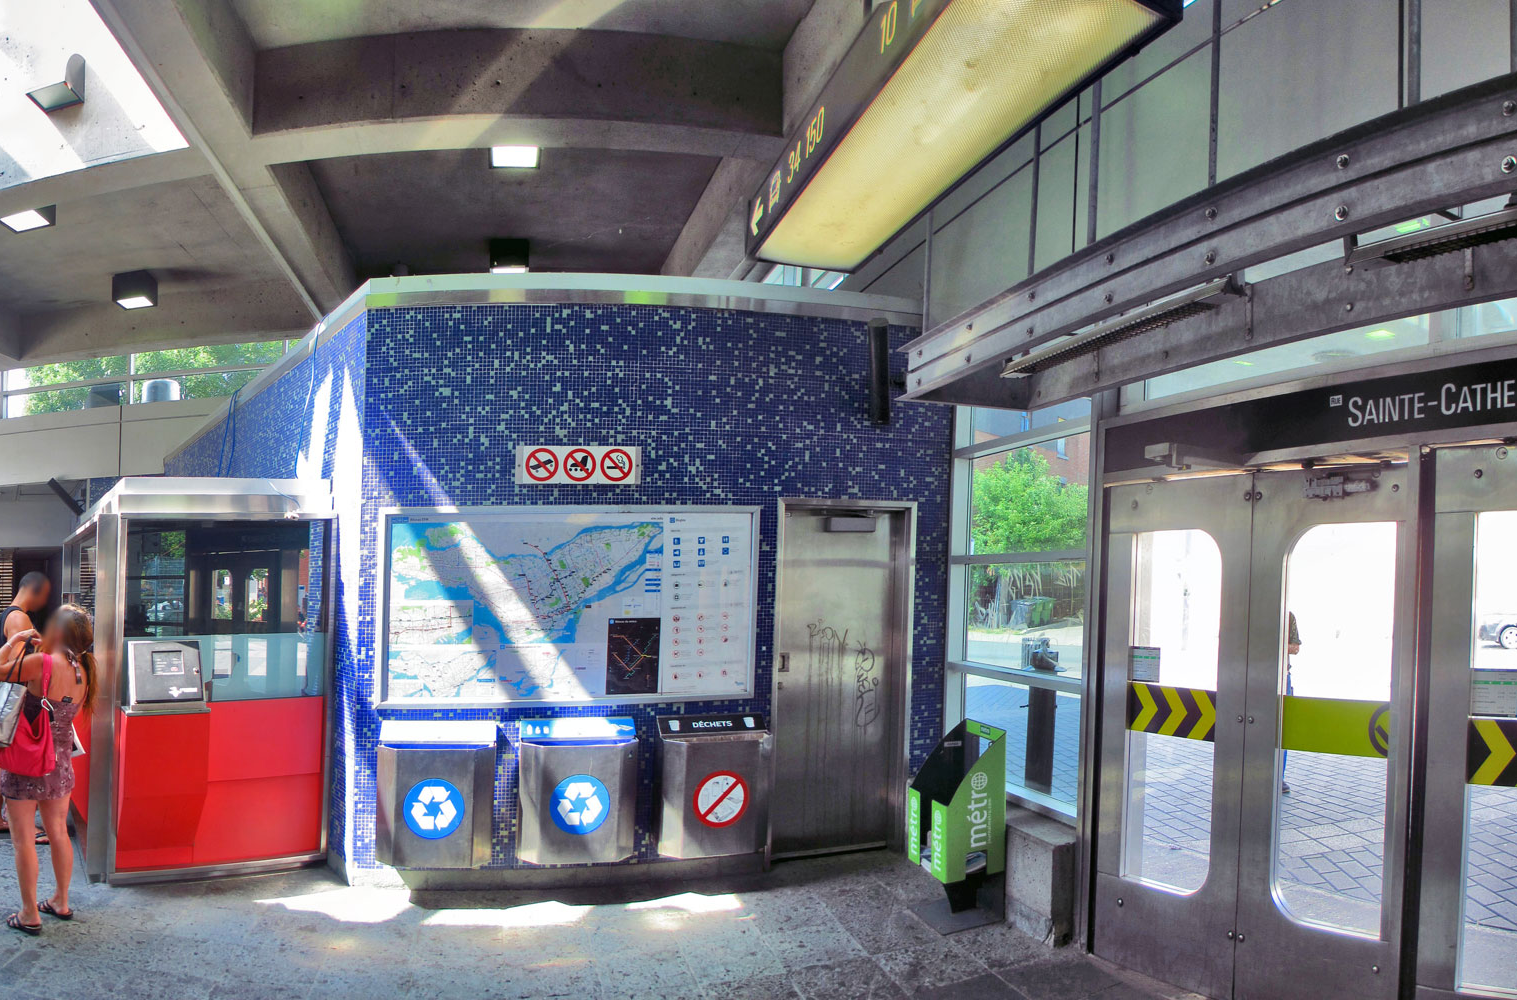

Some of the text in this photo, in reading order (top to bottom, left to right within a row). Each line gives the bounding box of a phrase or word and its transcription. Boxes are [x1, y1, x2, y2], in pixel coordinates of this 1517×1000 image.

[880, 0, 898, 54] 10
[787, 106, 825, 184] 34 150
[1347, 379, 1517, 427] SAINTE-CATHE
[692, 720, 733, 728] DÉCHETS
[910, 797, 918, 856] métro
[967, 771, 988, 848] métro
[933, 810, 942, 872] métro
